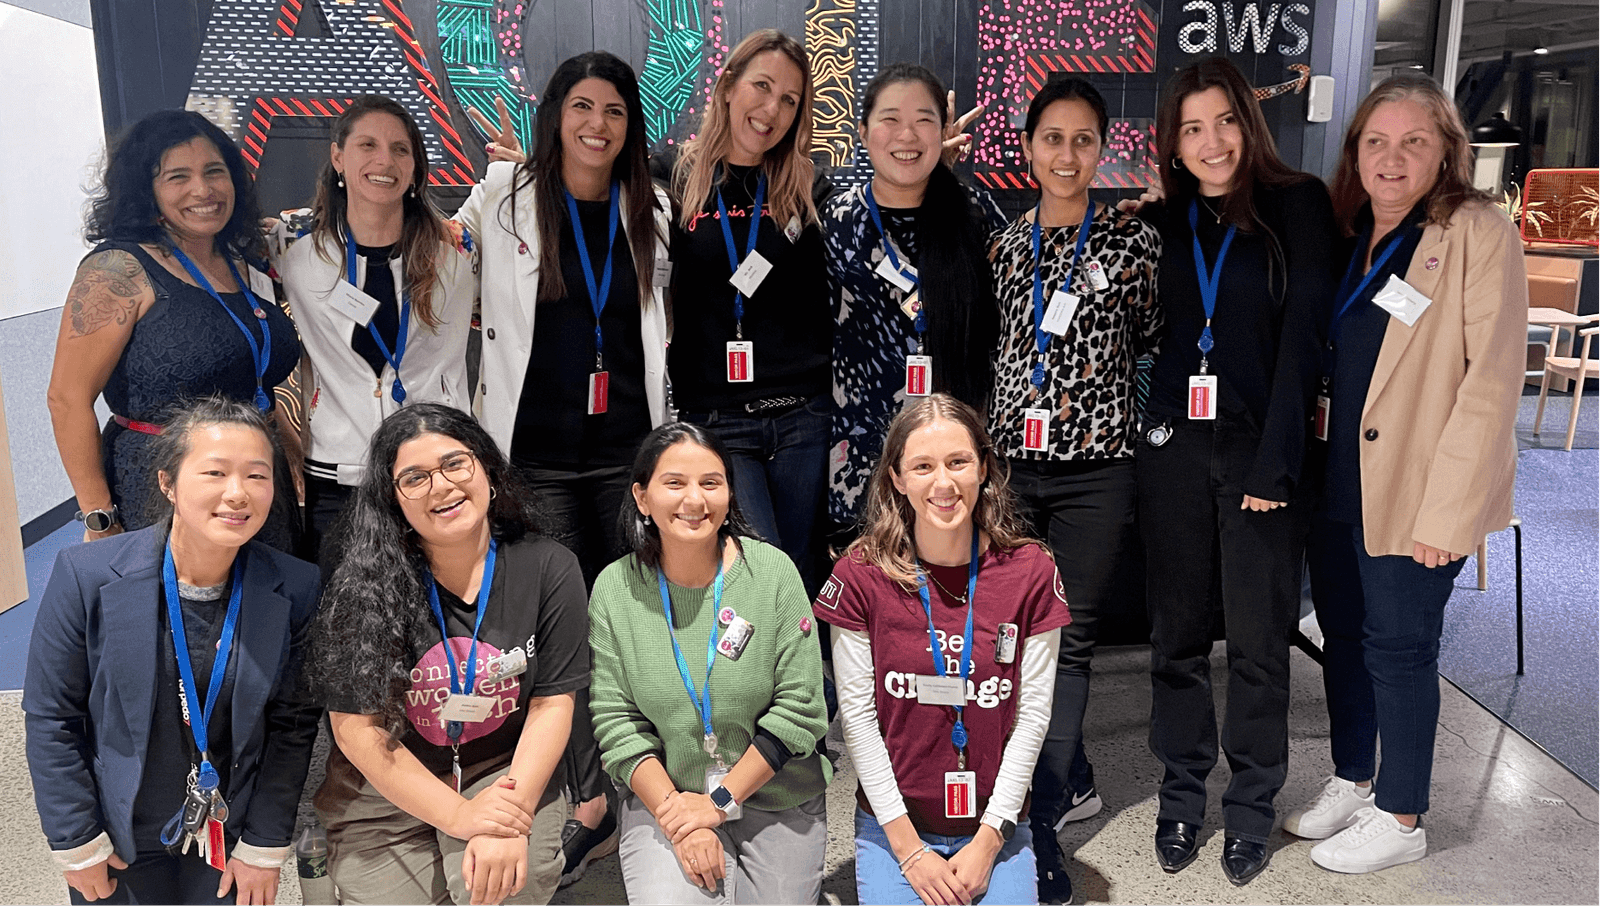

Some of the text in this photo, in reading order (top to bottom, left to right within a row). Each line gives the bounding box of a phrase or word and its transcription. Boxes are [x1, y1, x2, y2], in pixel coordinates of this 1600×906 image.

[1177, 0, 1310, 56] aws
[925, 629, 965, 653] Be
[944, 655, 976, 674] he
[405, 674, 520, 707] woen
[884, 670, 1013, 709] Cge
[416, 716, 431, 727] in
